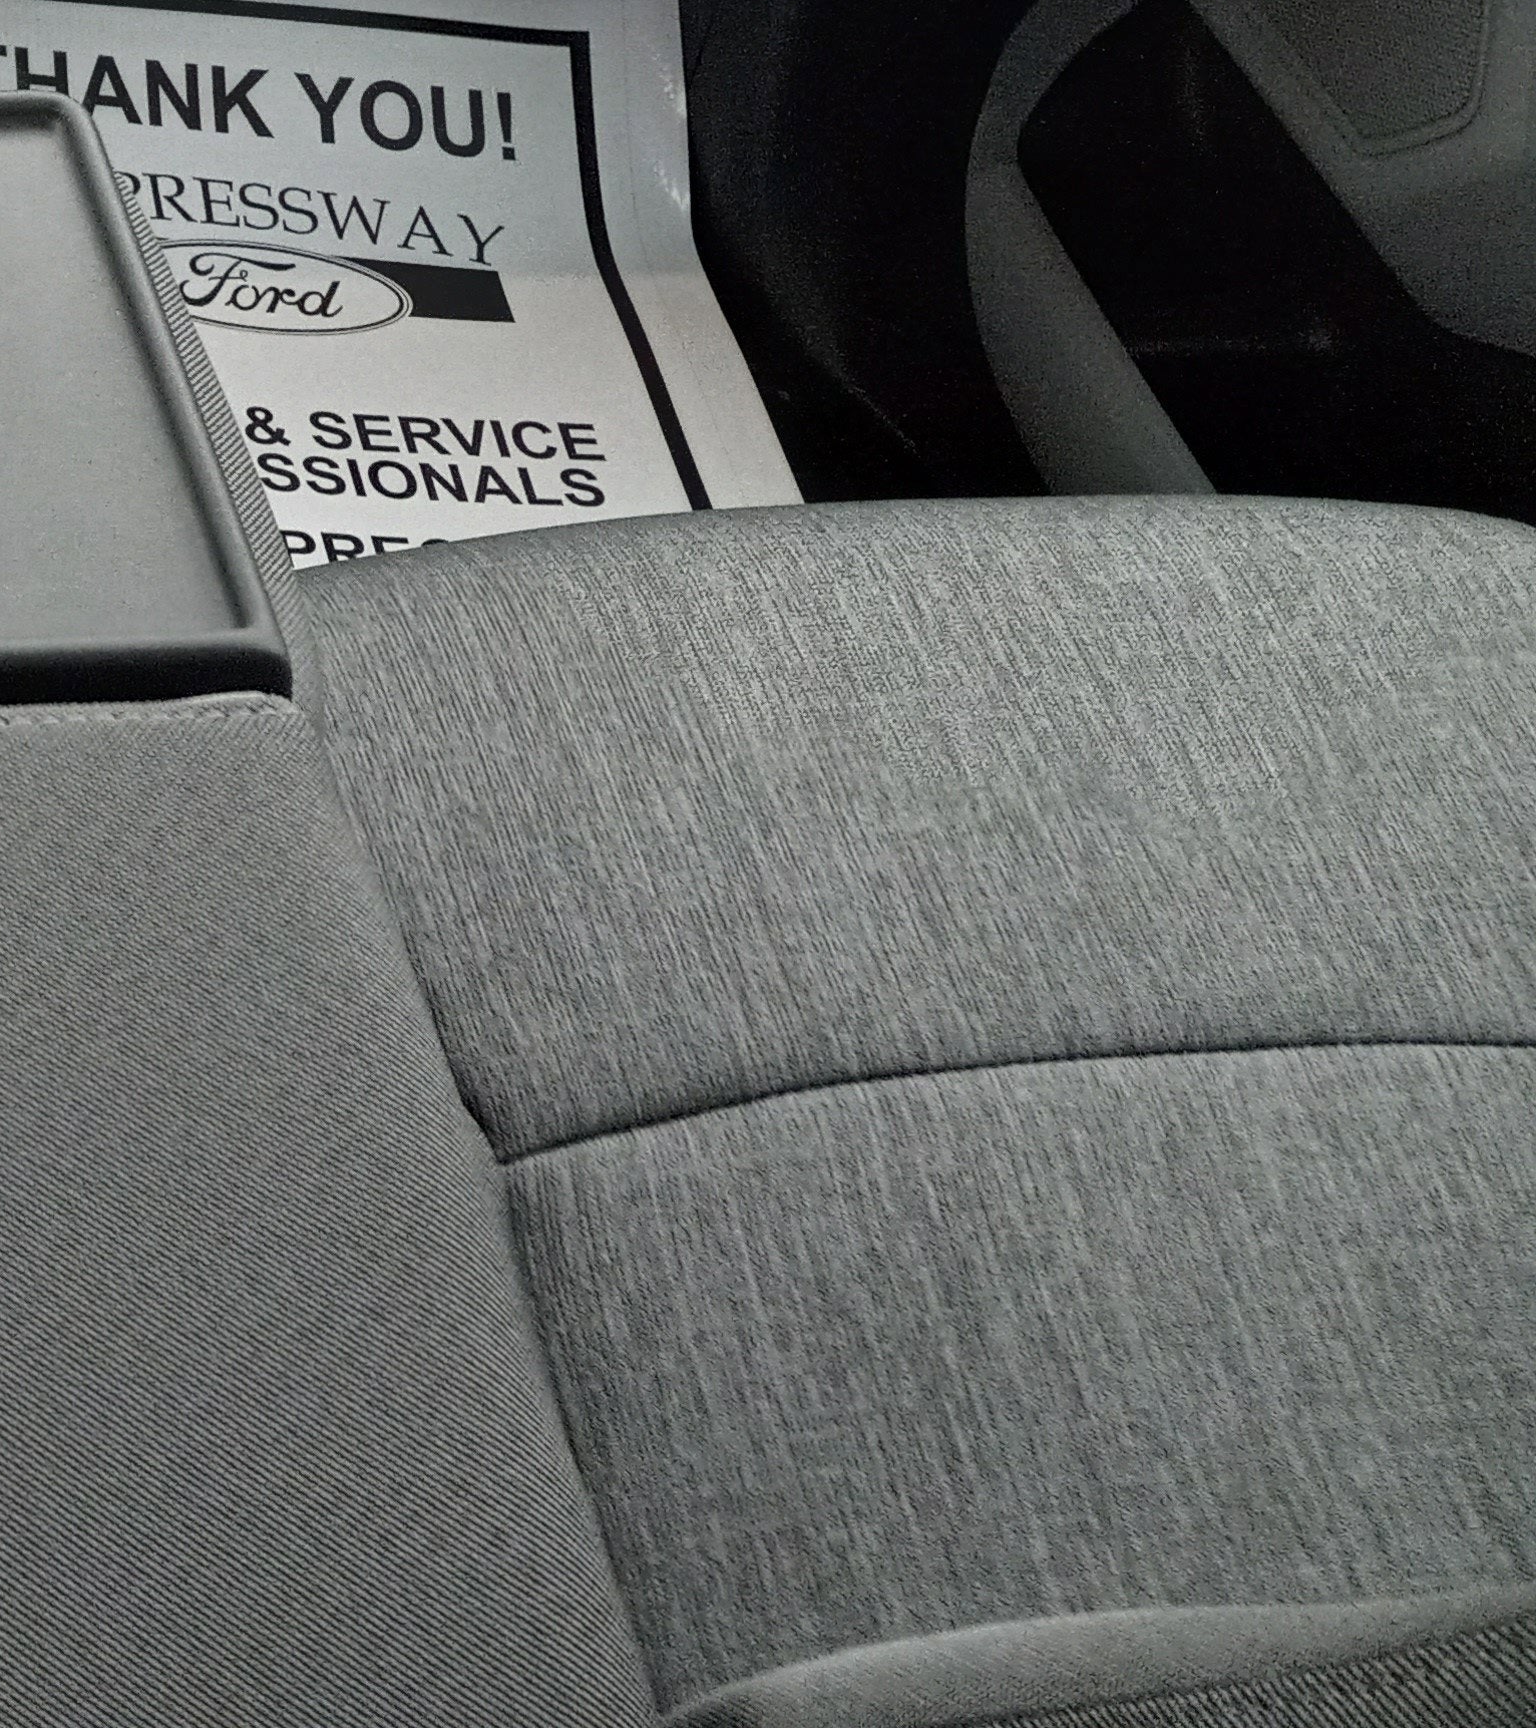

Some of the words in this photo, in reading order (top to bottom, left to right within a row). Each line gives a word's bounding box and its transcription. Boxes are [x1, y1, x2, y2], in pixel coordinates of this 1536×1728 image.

[294, 72, 516, 161] YOU!
[180, 251, 344, 319] Ford
[244, 406, 291, 447] &
[308, 410, 607, 462] SERVICE
[256, 452, 606, 508] SSIONALS
